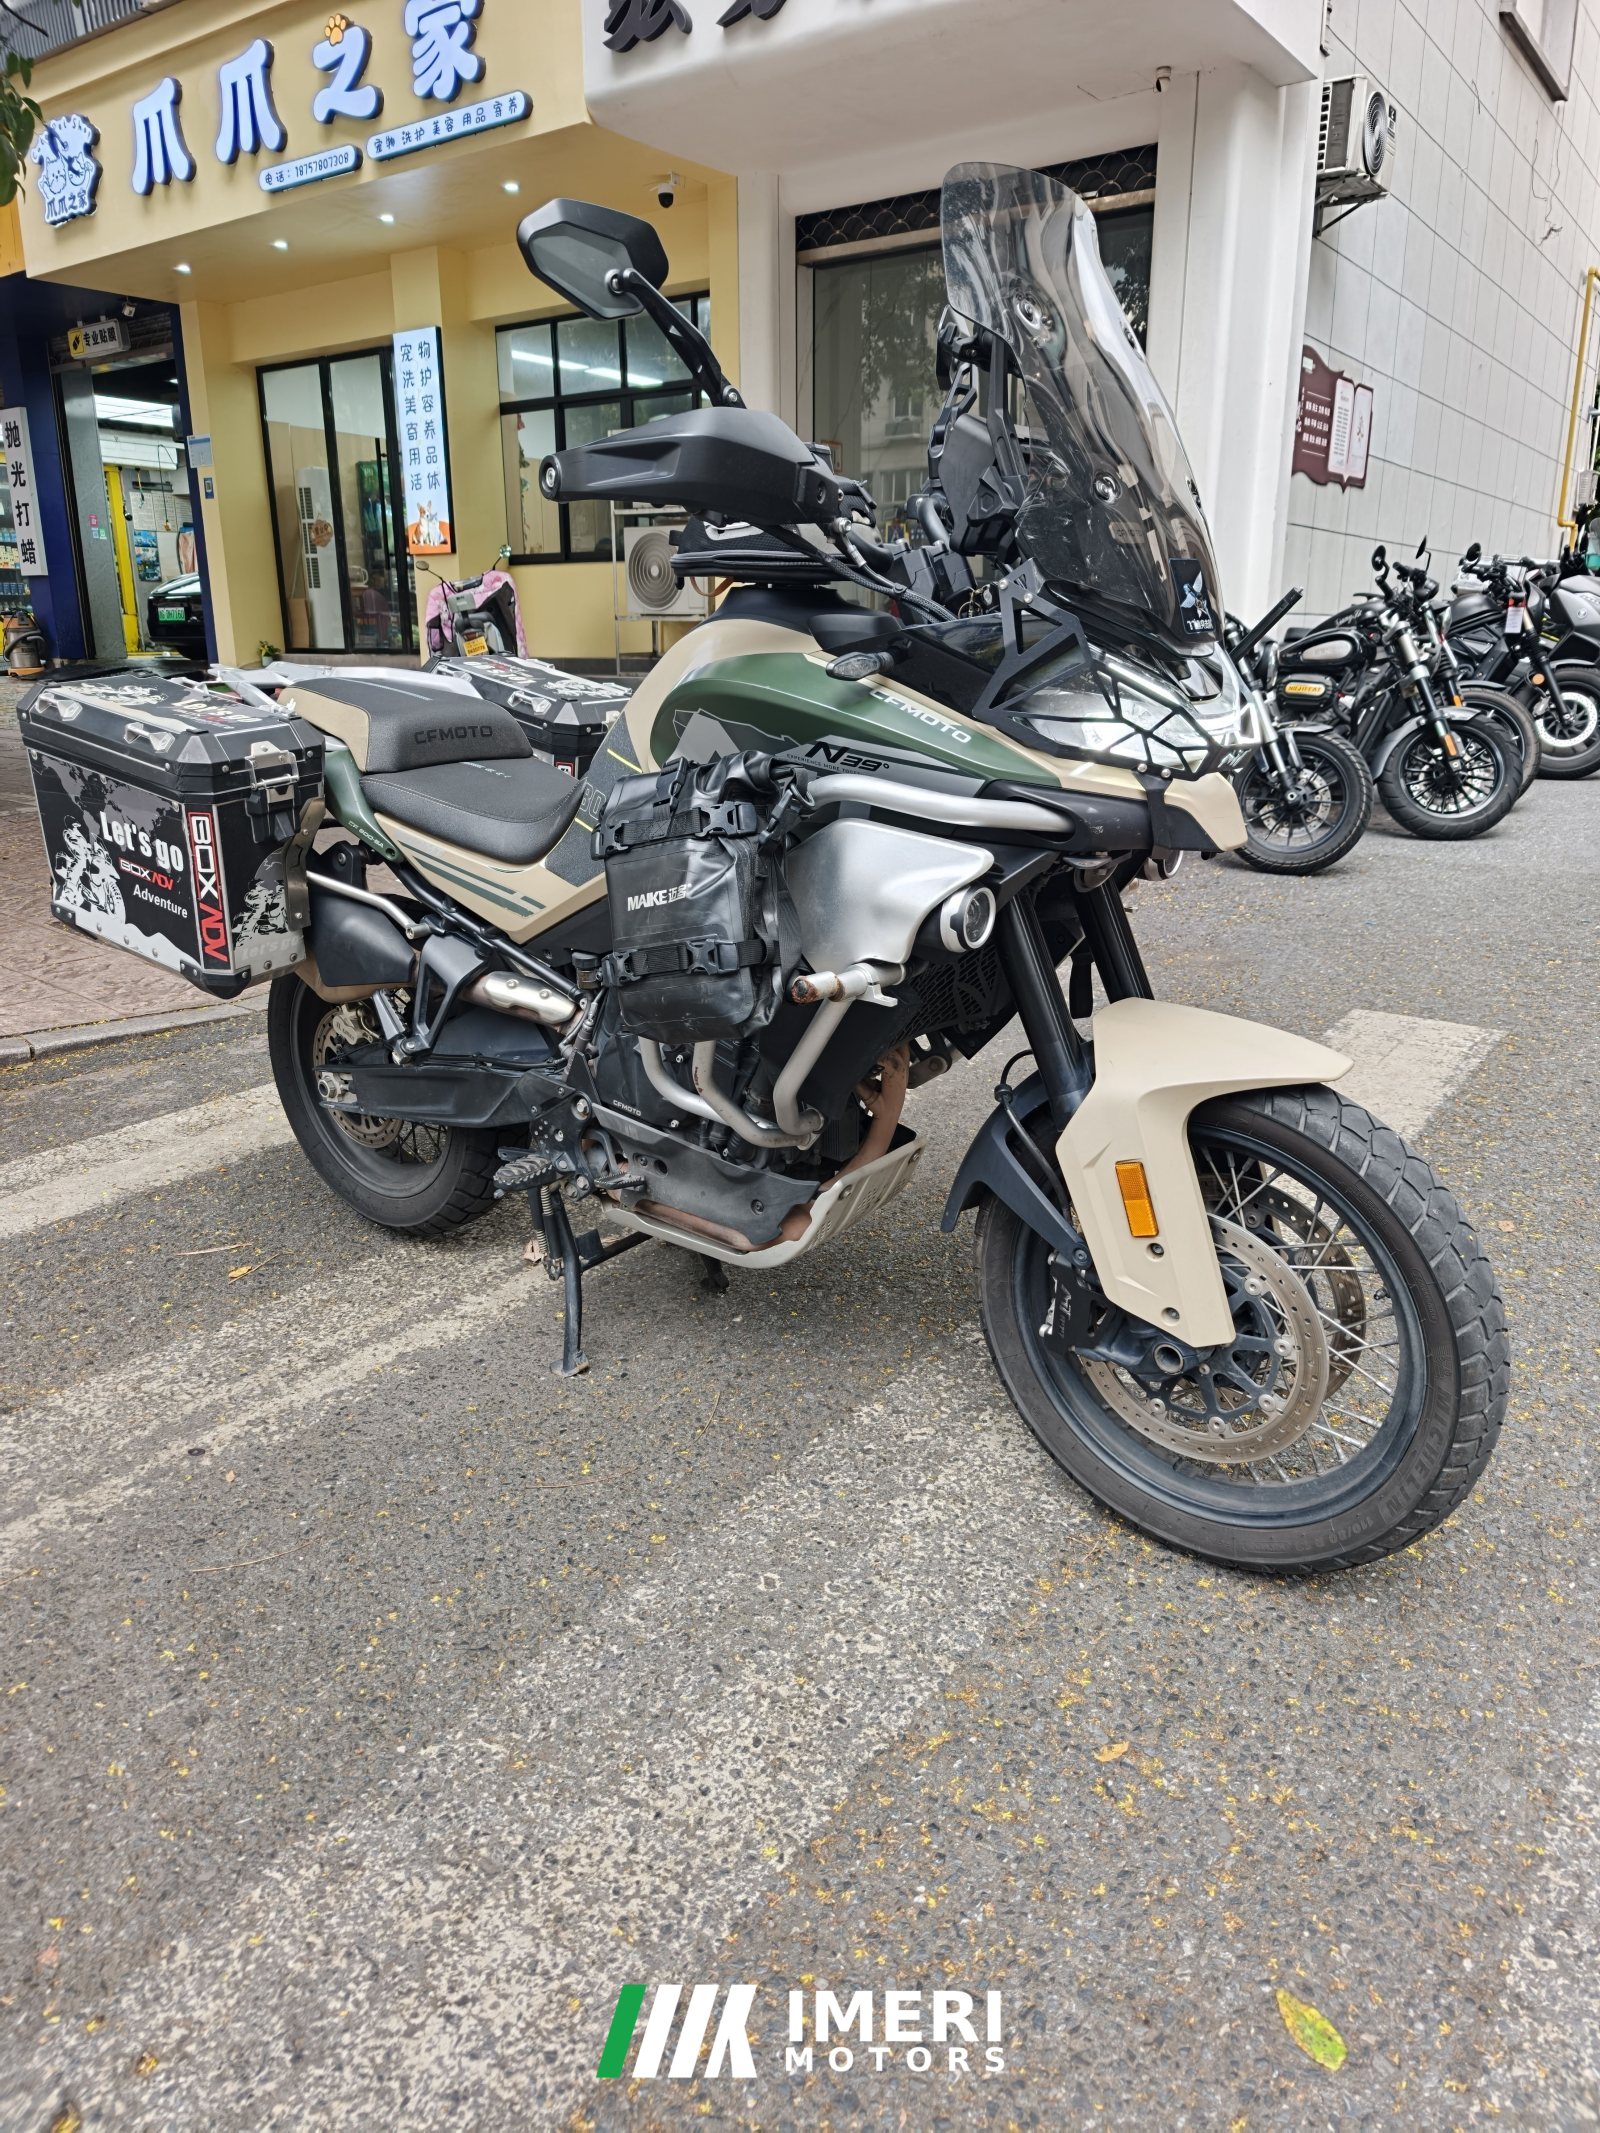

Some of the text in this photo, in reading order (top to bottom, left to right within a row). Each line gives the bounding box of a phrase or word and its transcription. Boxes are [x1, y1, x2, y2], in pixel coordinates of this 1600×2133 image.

[131, 0, 487, 196] 爪爪之家
[432, 116, 454, 136] 美容
[462, 107, 486, 127] 用品
[400, 339, 431, 362] 宠物
[402, 367, 432, 389] 洗护
[404, 394, 434, 416] 美容
[406, 420, 436, 441] 寄养
[408, 445, 438, 466] 用品
[410, 472, 440, 491] 活体
[4, 420, 37, 566] 抛光打蜡
[869, 688, 972, 743] CFMOTO
[414, 725, 493, 744] CFMOTO
[823, 763, 840, 772] MORE
[155, 838, 184, 871] go
[191, 816, 219, 900] BOX
[120, 859, 151, 881] BOX
[133, 884, 188, 919] Adventure
[627, 889, 668, 911] MAIKE
[613, 1099, 642, 1117] CFMOTO
